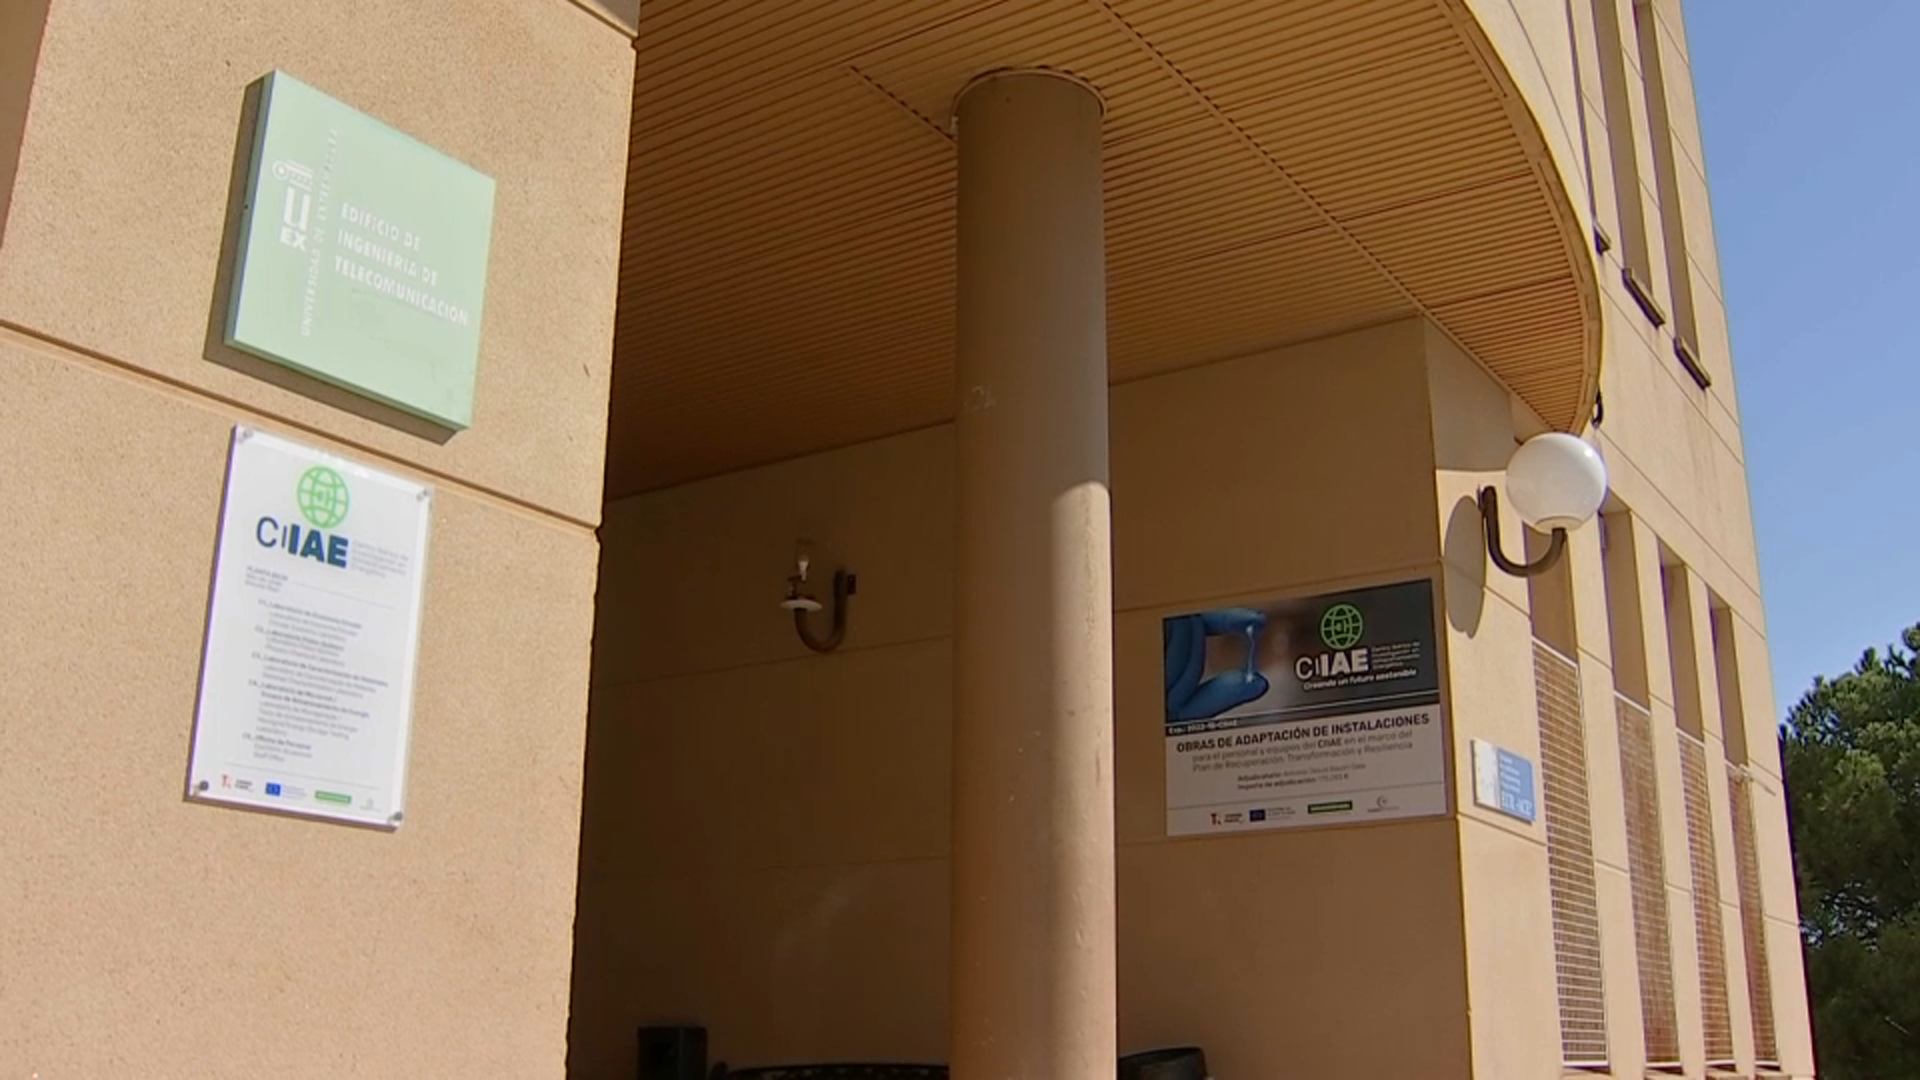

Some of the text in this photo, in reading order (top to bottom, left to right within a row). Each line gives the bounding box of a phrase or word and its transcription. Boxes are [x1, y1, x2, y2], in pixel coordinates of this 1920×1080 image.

[341, 202, 421, 251] EDIFICIO DE
[422, 267, 438, 286] DE
[1295, 648, 1369, 679] CIIAE
[1176, 712, 1430, 753] OBRAS DE ADAPTACIÓN DE INSTALACIONES
[1343, 737, 1356, 745] en
[1367, 733, 1396, 742] marco
[1397, 728, 1412, 738] del
[1213, 760, 1223, 769] de
